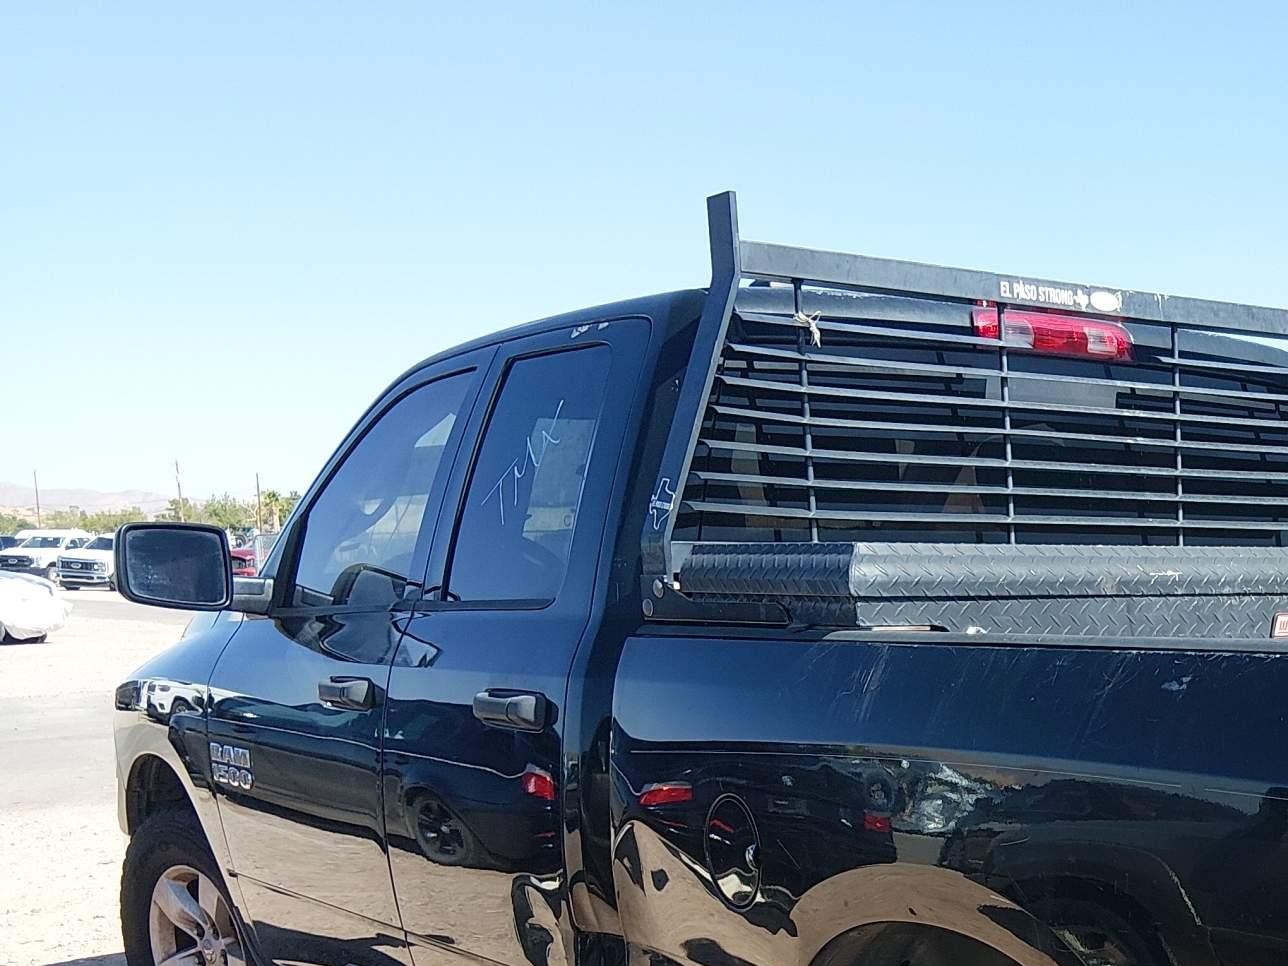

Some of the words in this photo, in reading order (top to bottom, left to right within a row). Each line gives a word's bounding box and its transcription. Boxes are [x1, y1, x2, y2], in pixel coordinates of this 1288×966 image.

[1001, 281, 1012, 298] EL
[1013, 280, 1037, 300] PASO
[1038, 286, 1074, 305] STRONG
[210, 742, 251, 768] RAM
[212, 763, 253, 790] 1500
